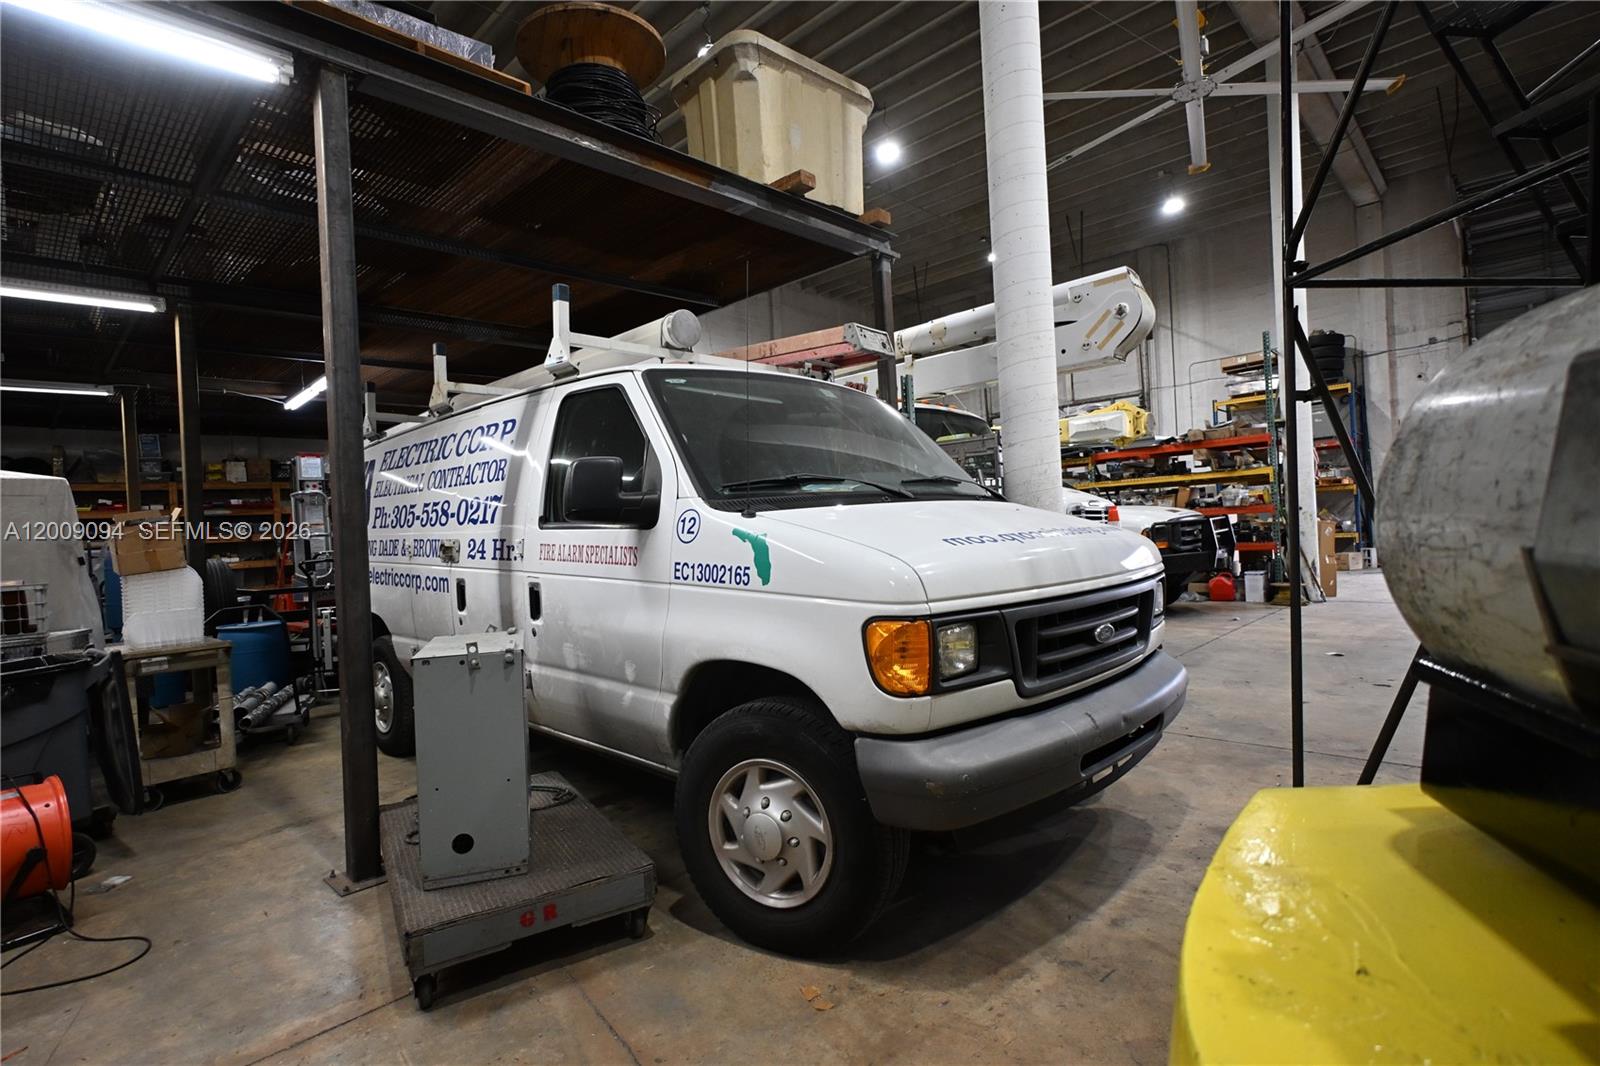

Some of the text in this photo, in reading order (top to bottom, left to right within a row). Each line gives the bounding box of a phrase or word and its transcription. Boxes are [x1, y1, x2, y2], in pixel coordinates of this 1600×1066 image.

[380, 433, 457, 472] ELECTRIC
[374, 473, 425, 498] ELECTRICAL
[427, 459, 508, 491] CONTRACTOR
[681, 517, 697, 535] 12
[378, 539, 400, 557] DADE
[413, 538, 441, 558] BROW
[467, 538, 517, 561] 24 Hr.
[539, 543, 639, 567] FIRE ALARM SPECIALISTS
[674, 561, 751, 586] EC13002165
